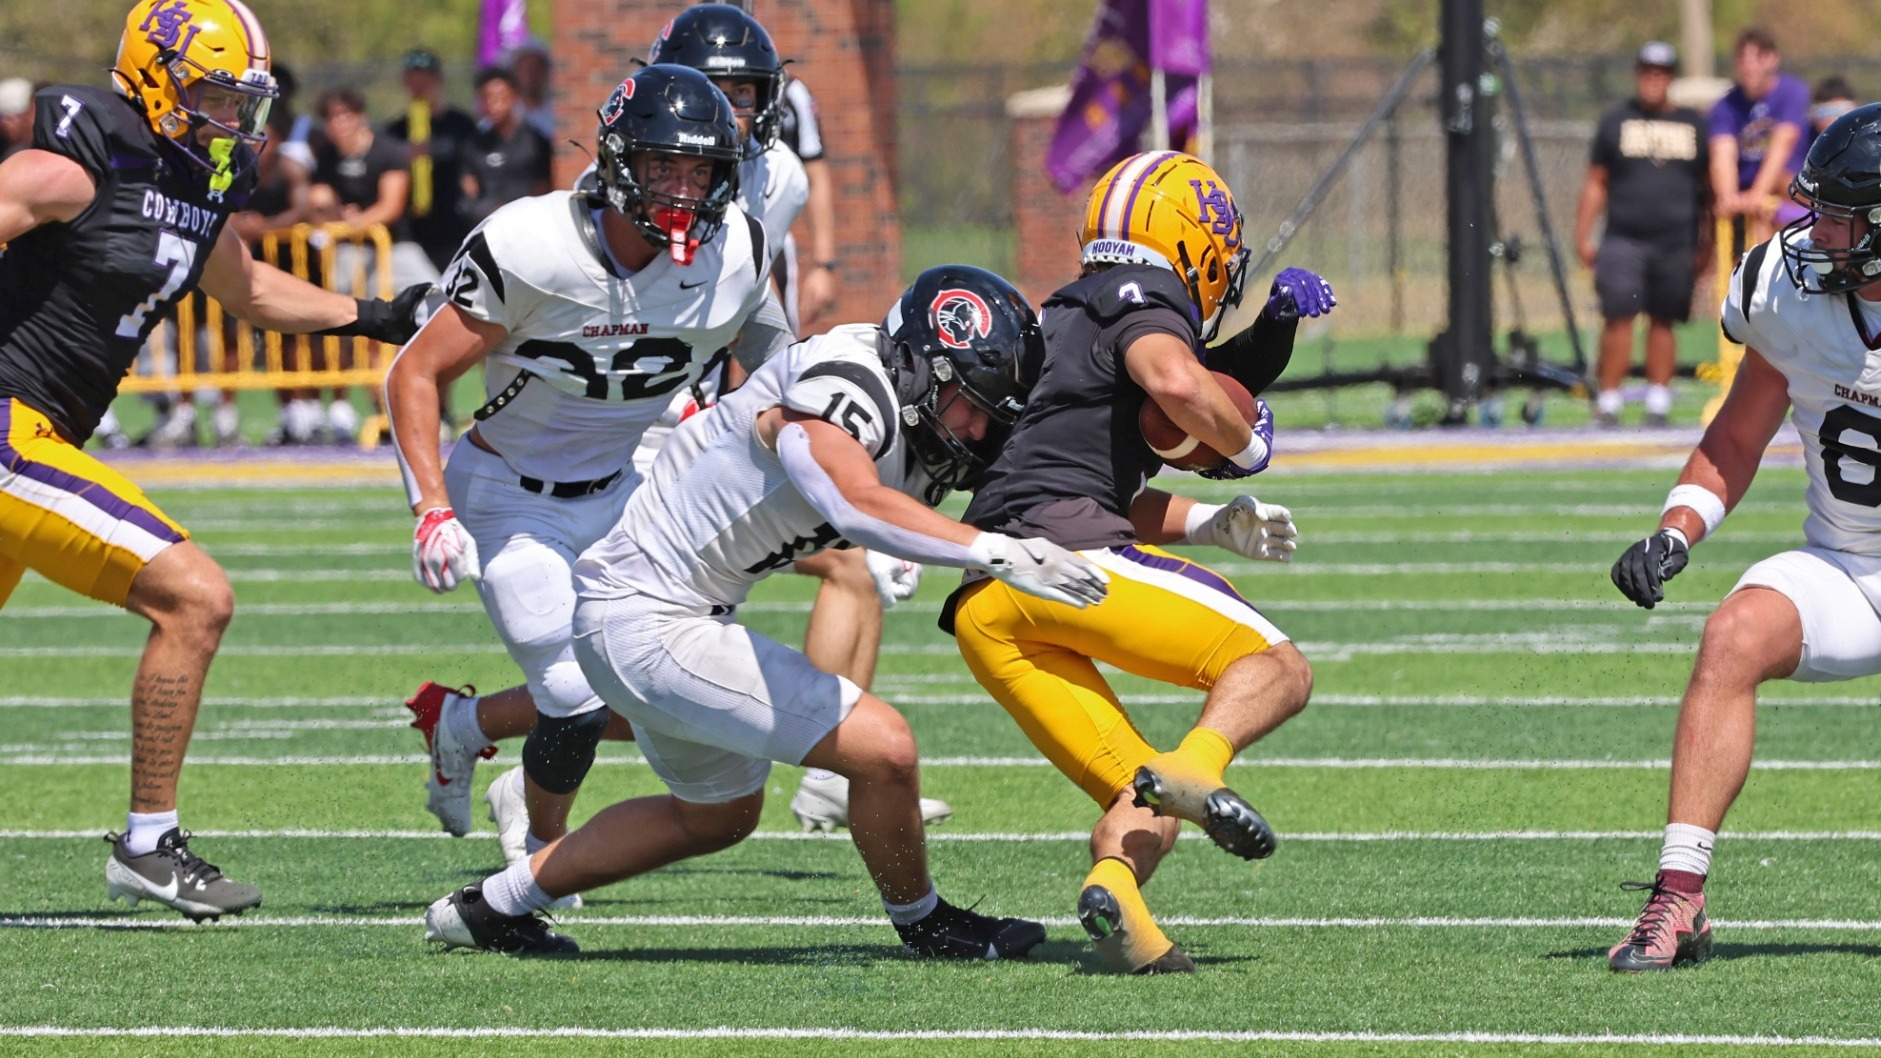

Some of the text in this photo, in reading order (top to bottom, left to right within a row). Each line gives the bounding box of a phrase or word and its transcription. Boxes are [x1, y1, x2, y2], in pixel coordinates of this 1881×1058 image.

[55, 94, 85, 140] 7
[677, 132, 716, 146] Riddell
[1091, 240, 1136, 257] HOOYAH
[115, 228, 198, 339] 7
[582, 322, 650, 338] CHAPMAN
[514, 337, 693, 401] 32
[1834, 384, 1881, 408] CHAPM
[821, 391, 873, 441] 15
